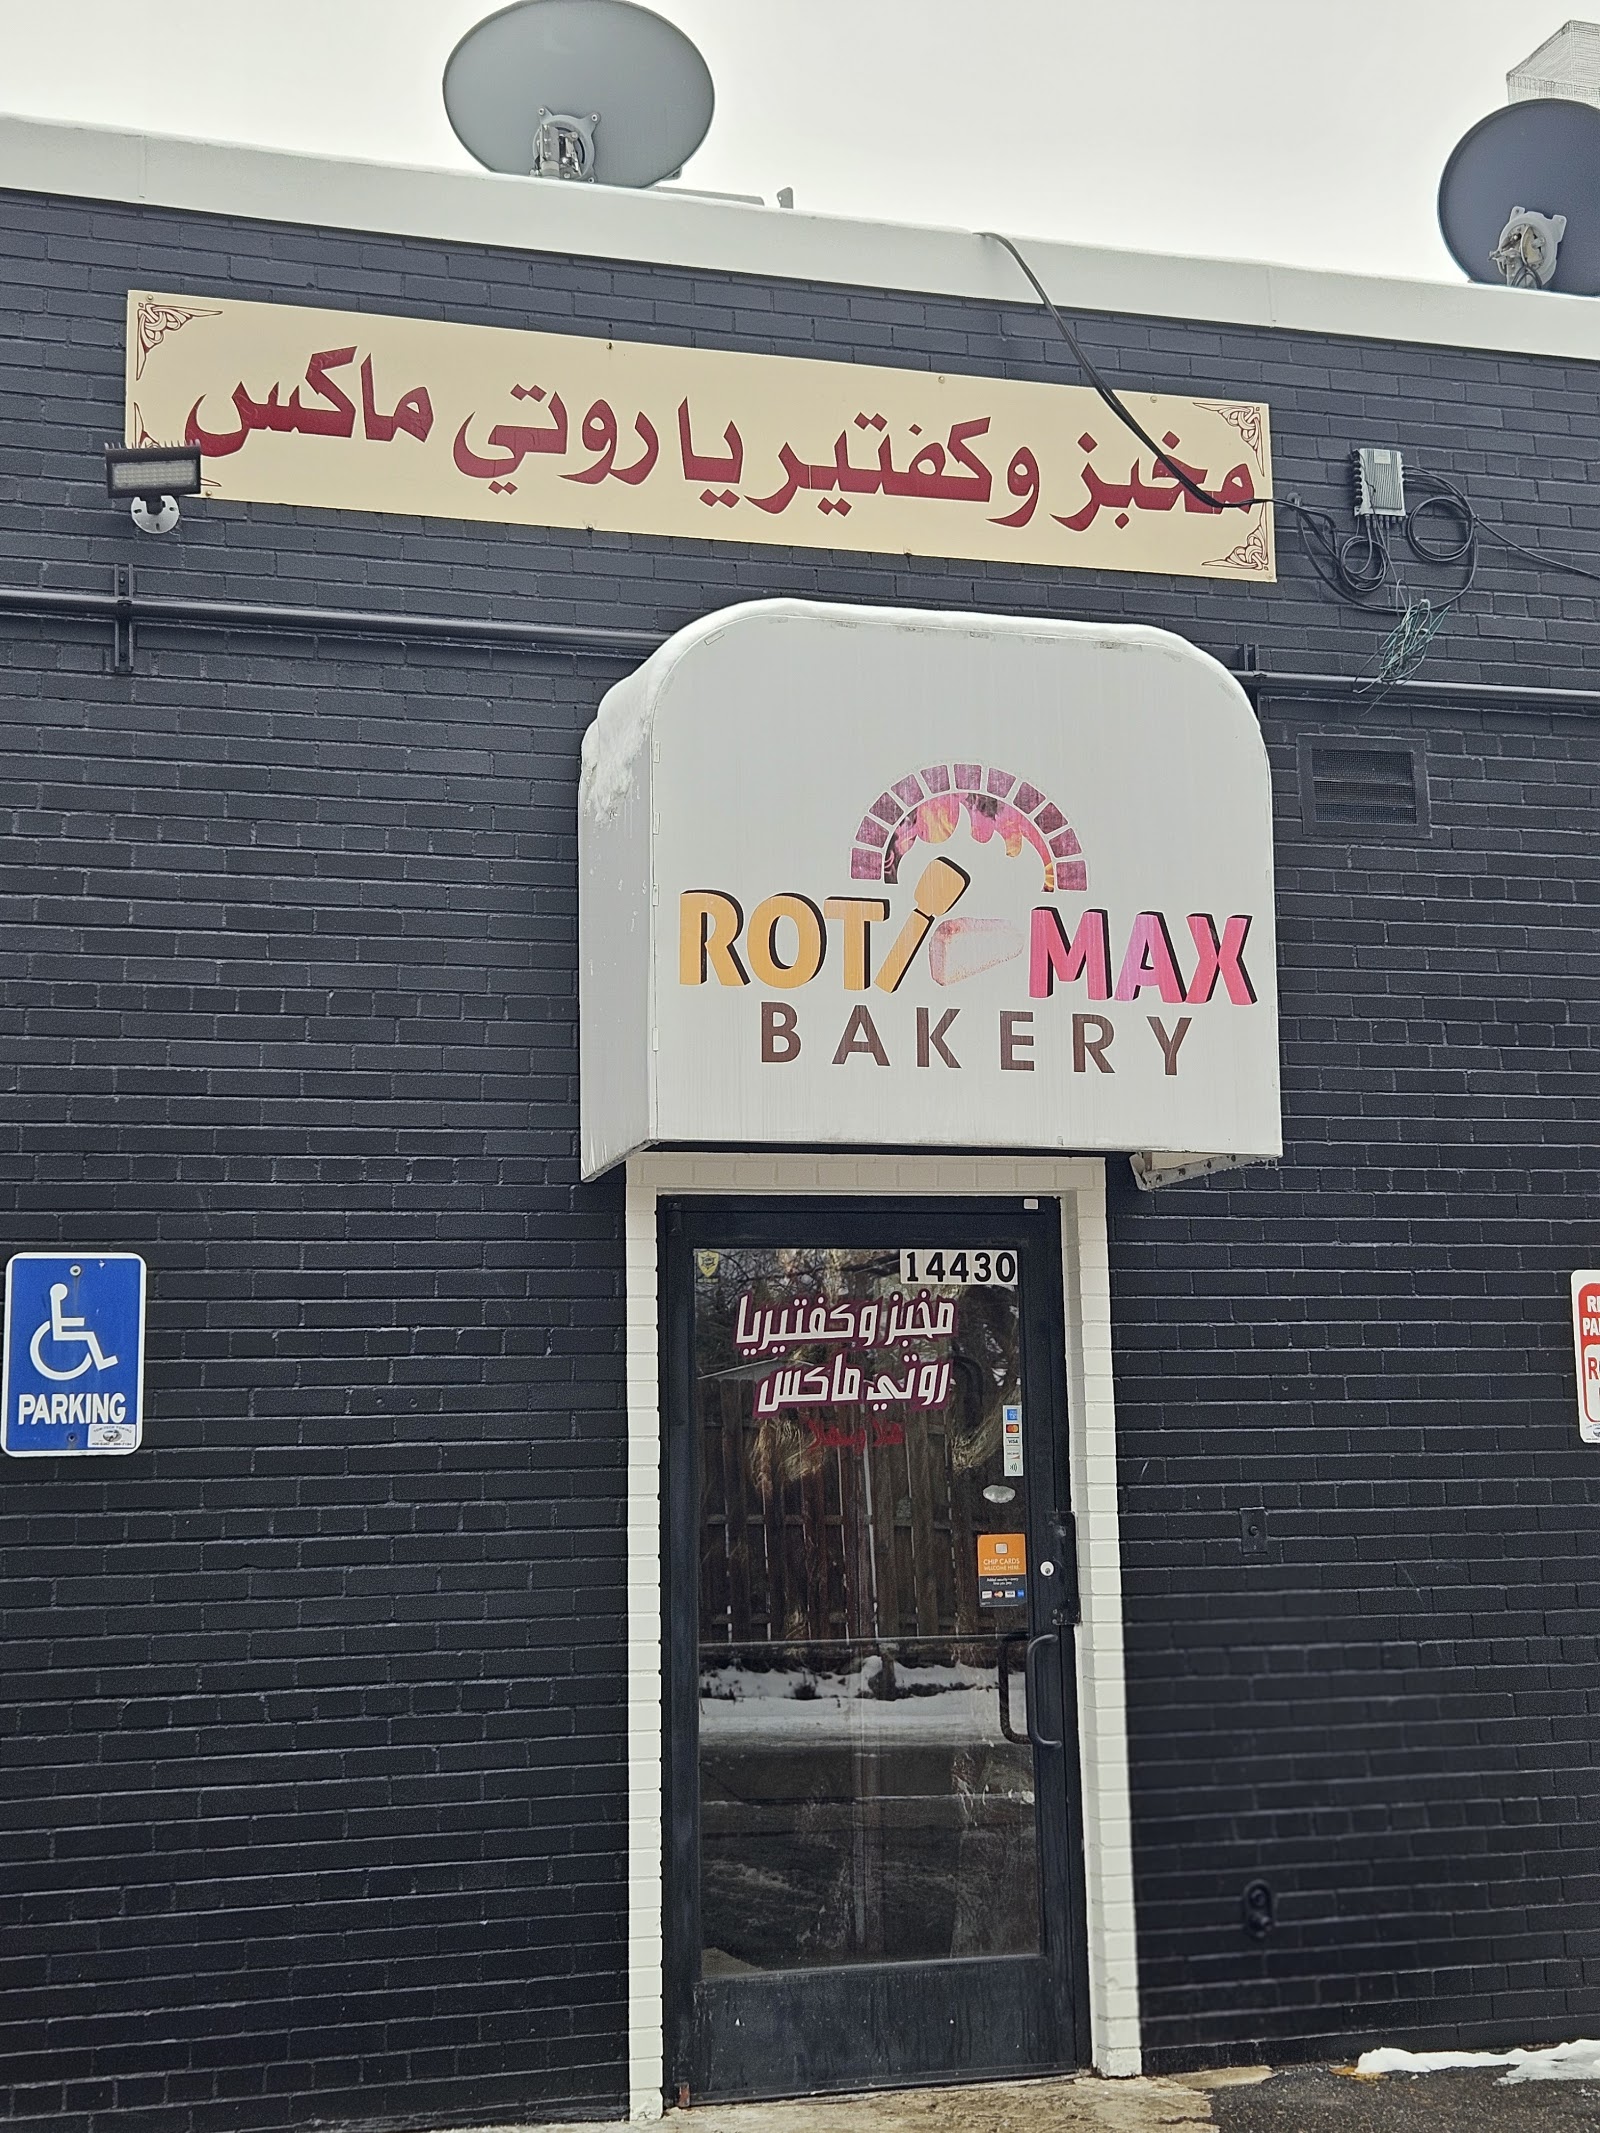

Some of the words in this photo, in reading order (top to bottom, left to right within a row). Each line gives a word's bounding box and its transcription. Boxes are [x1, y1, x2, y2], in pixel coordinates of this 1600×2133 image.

[186, 346, 432, 458] ماكس
[453, 382, 660, 498] روتي
[1049, 431, 1255, 532] مخبز
[1029, 906, 1258, 1006] MAX
[761, 1001, 1192, 1076] BAKERY
[906, 1251, 1017, 1283] 14430
[883, 1289, 956, 1348] مخبز
[18, 1392, 126, 1425] PARKING
[756, 1353, 862, 1413] ماكس
[865, 1353, 950, 1412] روتي
